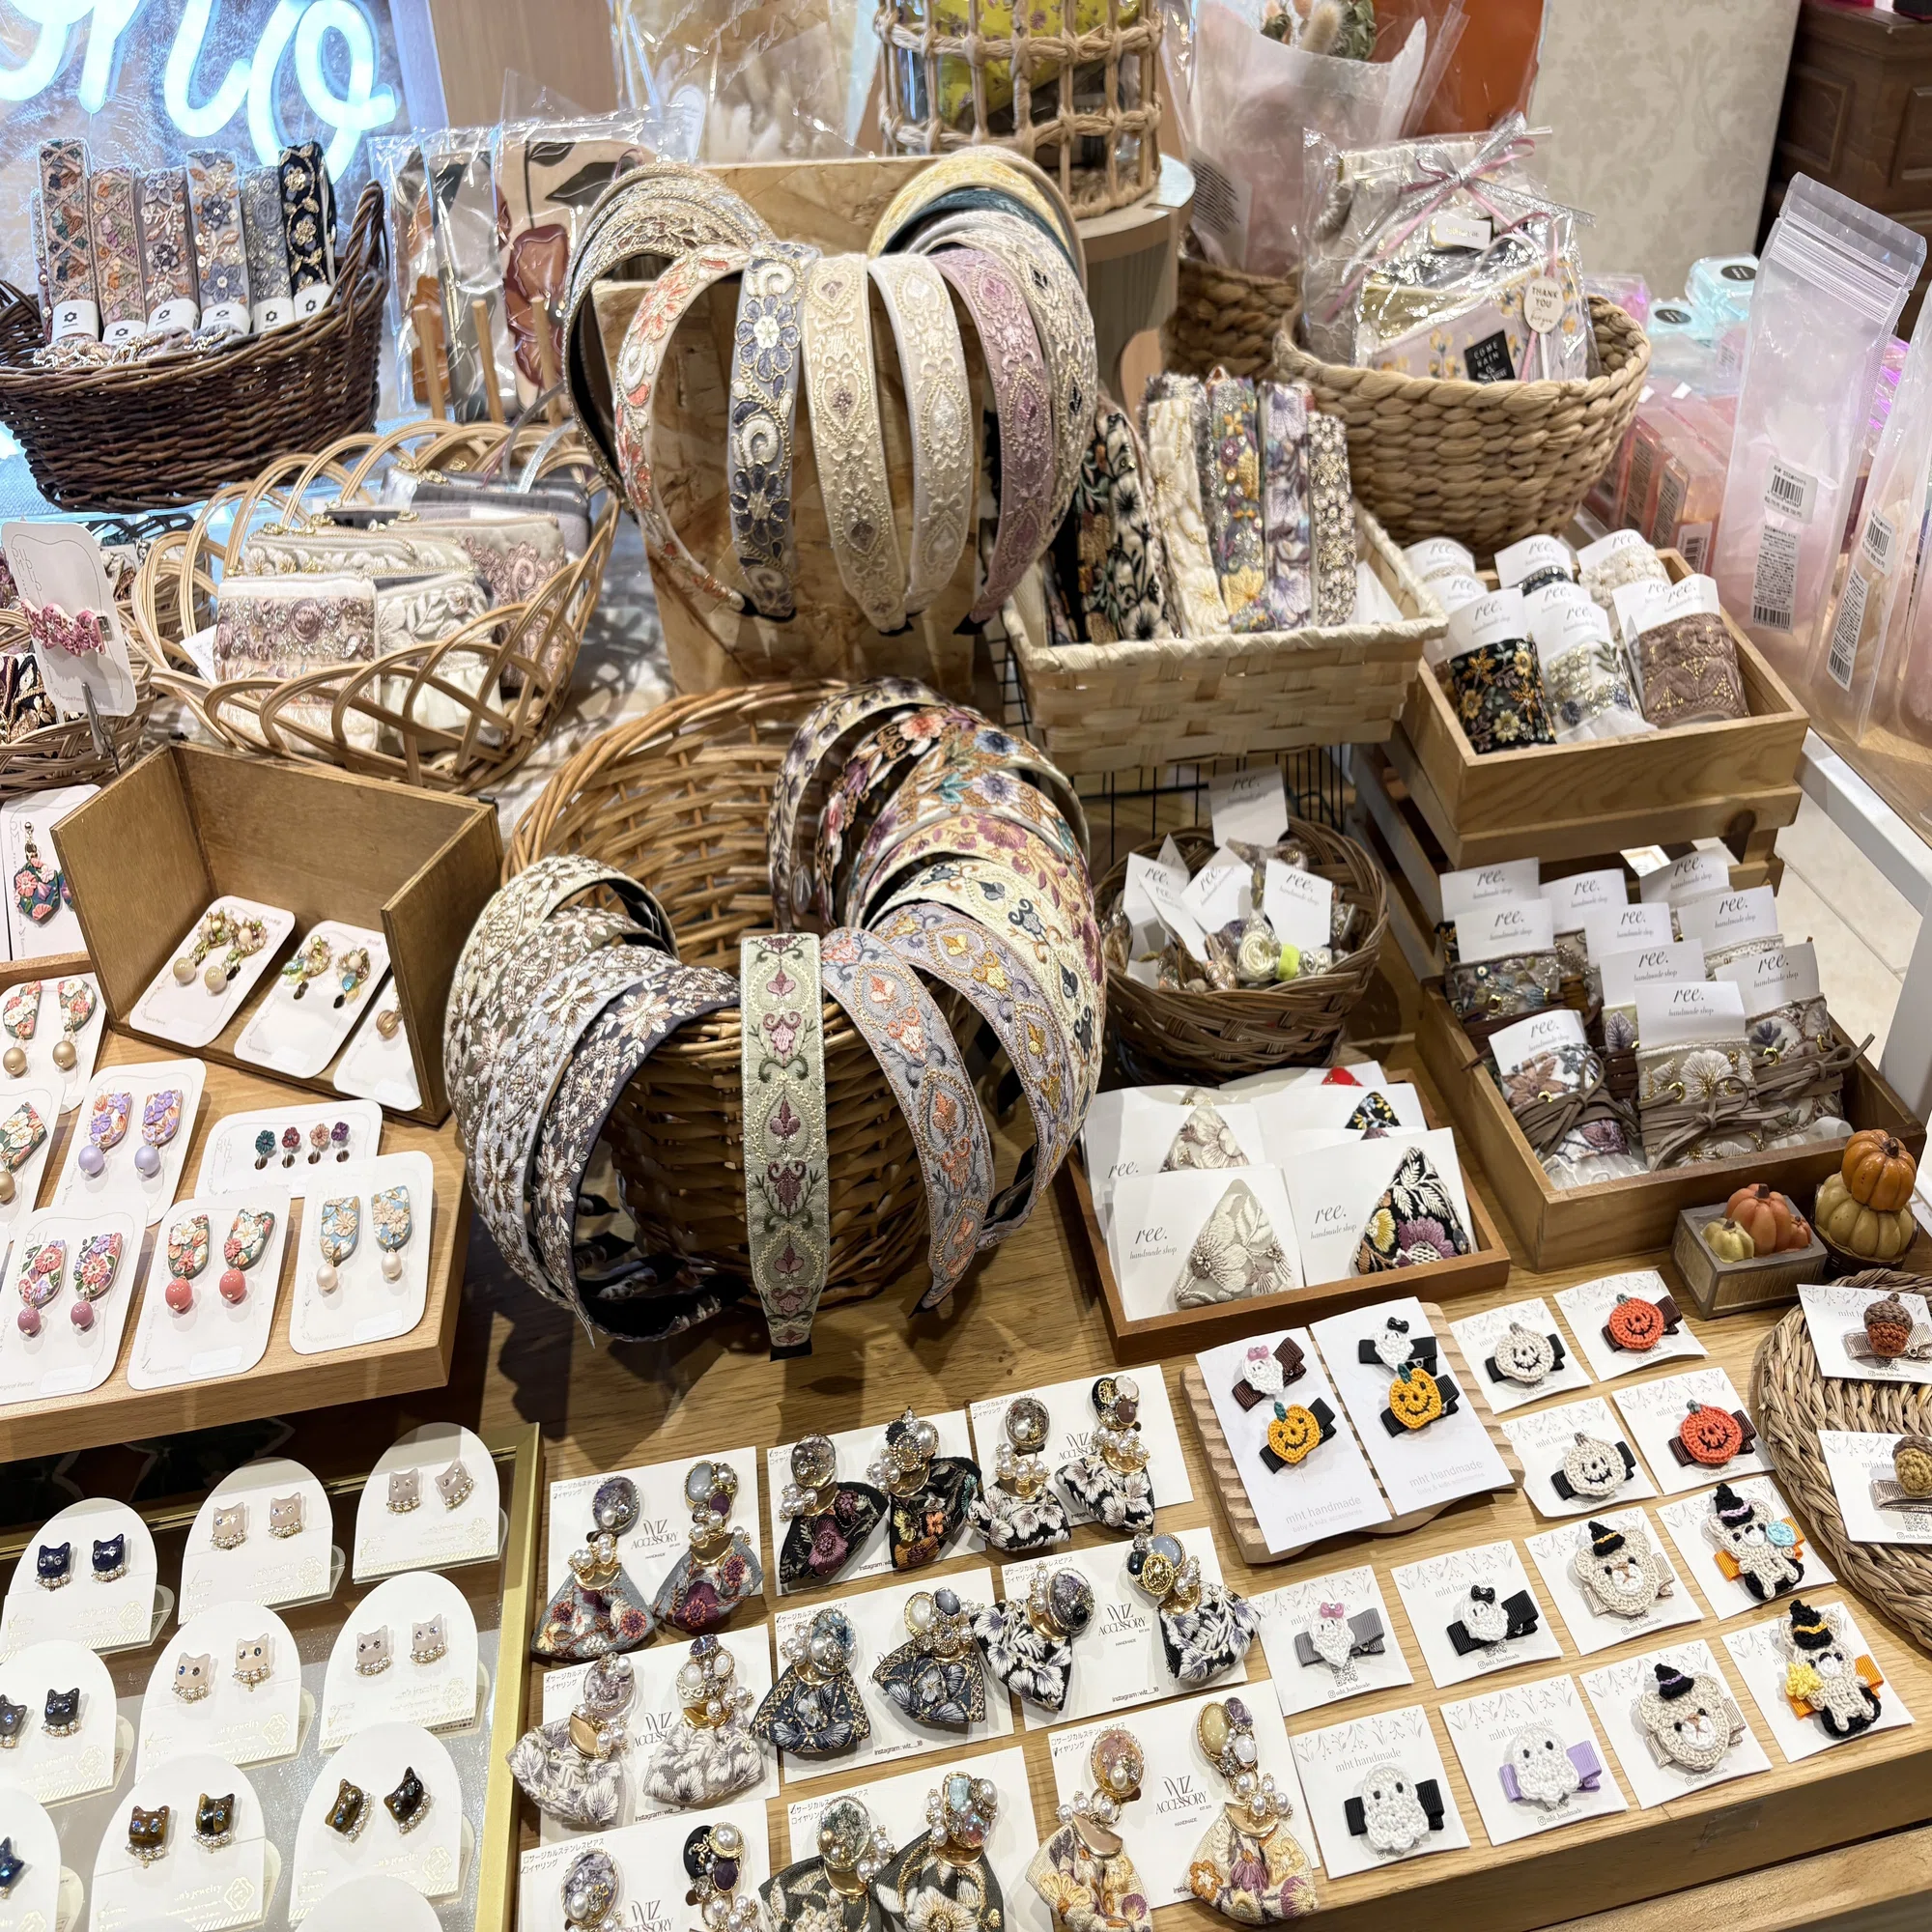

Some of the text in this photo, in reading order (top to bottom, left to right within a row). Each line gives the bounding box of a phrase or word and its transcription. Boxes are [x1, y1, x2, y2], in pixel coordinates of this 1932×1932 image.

[1535, 298, 1552, 309] YOU
[1673, 856, 1704, 877] ree.
[1287, 872, 1314, 893] ree.
[1477, 869, 1505, 887] ree.
[1574, 879, 1601, 895] ree.
[1719, 895, 1747, 915] ree.
[1494, 910, 1524, 927] ree.
[1620, 910, 1646, 925] ree.
[1637, 951, 1669, 968] ree.
[1757, 953, 1789, 974] ree.
[1673, 988, 1704, 1003] ree.
[1530, 1019, 1560, 1038] ree.
[1108, 1160, 1139, 1179] ree.
[1315, 1204, 1347, 1224] ree.
[1134, 1226, 1168, 1245] ree.
[1310, 1227, 1342, 1240] handmade
[1129, 1247, 1161, 1260] handmade
[1408, 1460, 1483, 1488] mht handmade
[1285, 1495, 1362, 1524] mht handmade
[643, 1519, 668, 1540] WIZ
[630, 1531, 680, 1550] ACCESSORY
[1105, 1603, 1134, 1625] WIZ
[1097, 1616, 1147, 1636] ACCESSORY
[644, 1711, 672, 1733] WIZ
[1489, 1727, 1506, 1742] mht
[1059, 1741, 1085, 1753] イヤリング
[1335, 1747, 1402, 1773] mht handmade
[1161, 1775, 1193, 1800] WIZ
[1155, 1791, 1208, 1815] ACCESSORY
[1174, 1817, 1198, 1827] HANDMADE
[528, 1859, 558, 1873] イヤリング
[630, 1899, 662, 1924] WIZ
